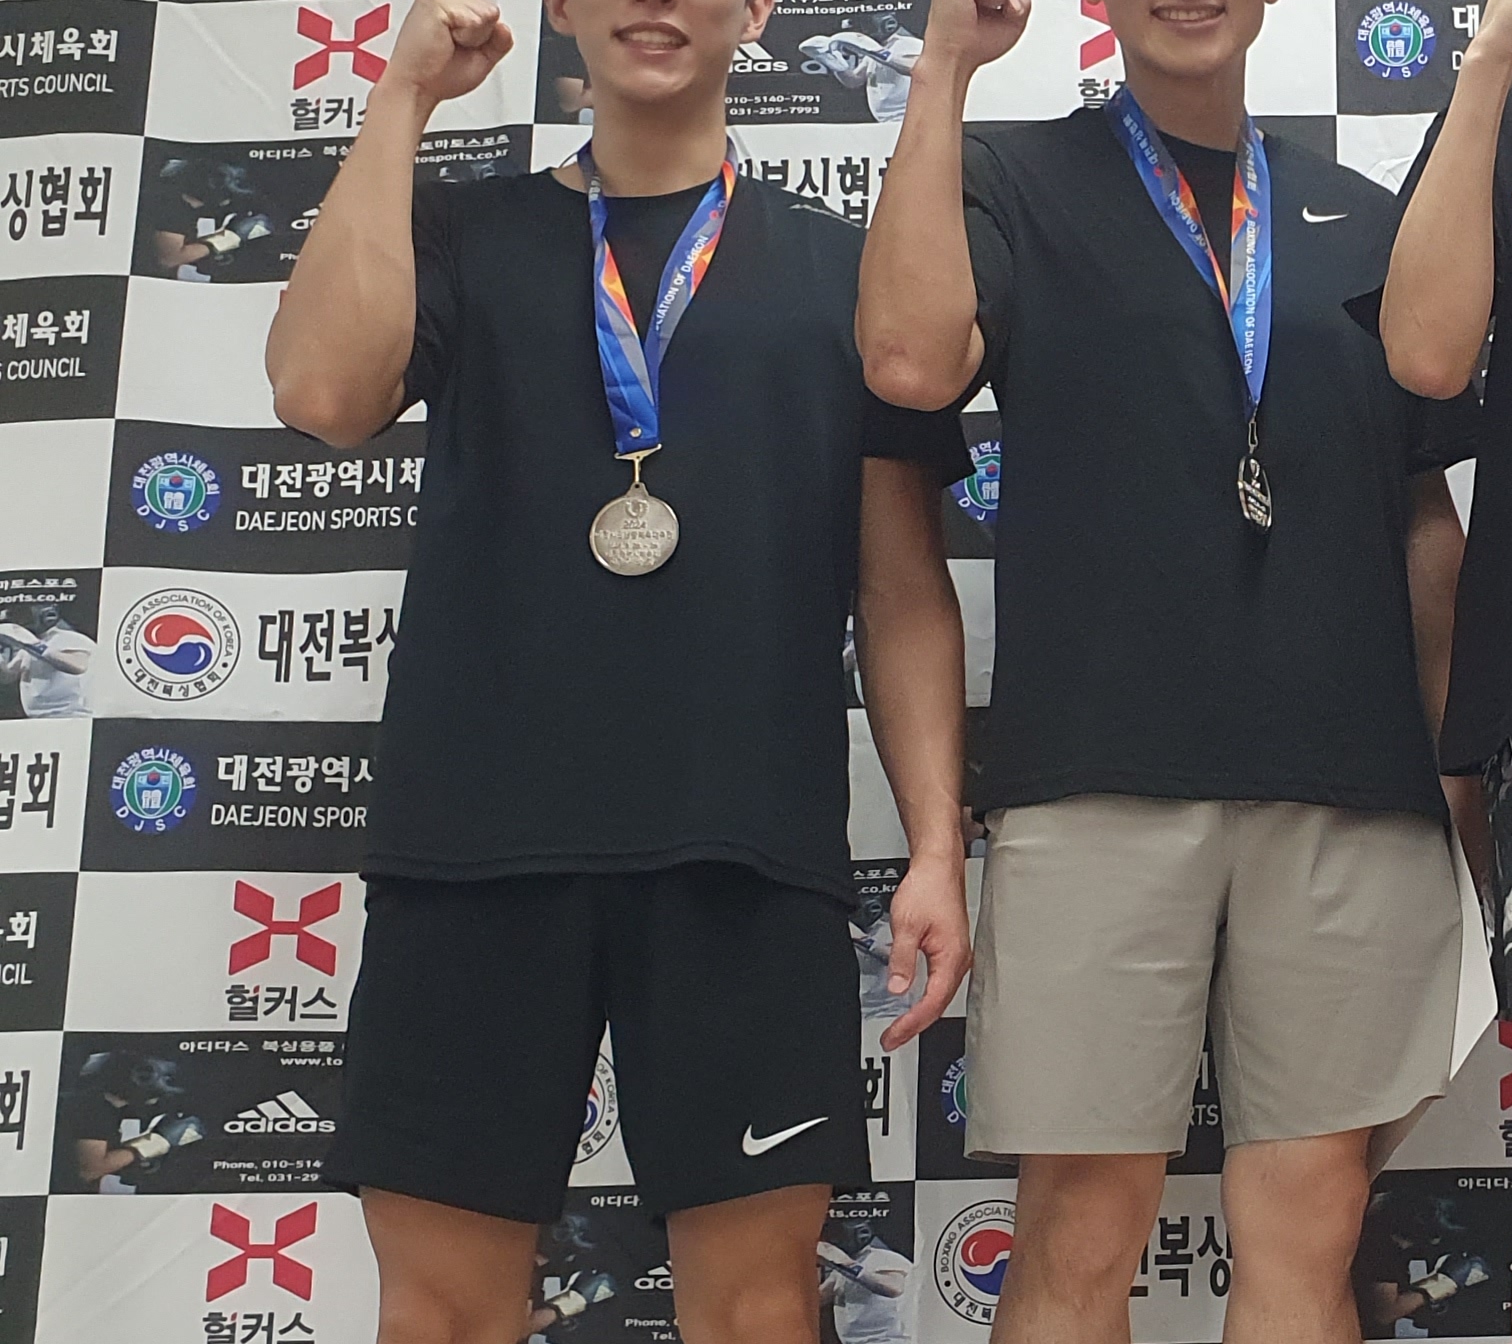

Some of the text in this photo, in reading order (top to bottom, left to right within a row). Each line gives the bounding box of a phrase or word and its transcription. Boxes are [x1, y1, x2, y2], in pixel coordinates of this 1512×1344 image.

[33, 74, 113, 95] COUNCIL
[724, 94, 821, 104] 010-5140-7991
[730, 105, 820, 115] 031-295-7993
[249, 147, 312, 159] 아디다스
[1245, 220, 1256, 256] BOXING
[1246, 258, 1257, 324] ASSOCIATION
[7, 359, 85, 381] COUNCIL
[236, 507, 401, 531] DAEJEON SPORTS
[211, 806, 307, 827] DAEJEON
[225, 985, 338, 1022] 헐커스
[180, 1040, 335, 1053] 아디다스 복싱용품
[224, 1119, 336, 1134] adidas
